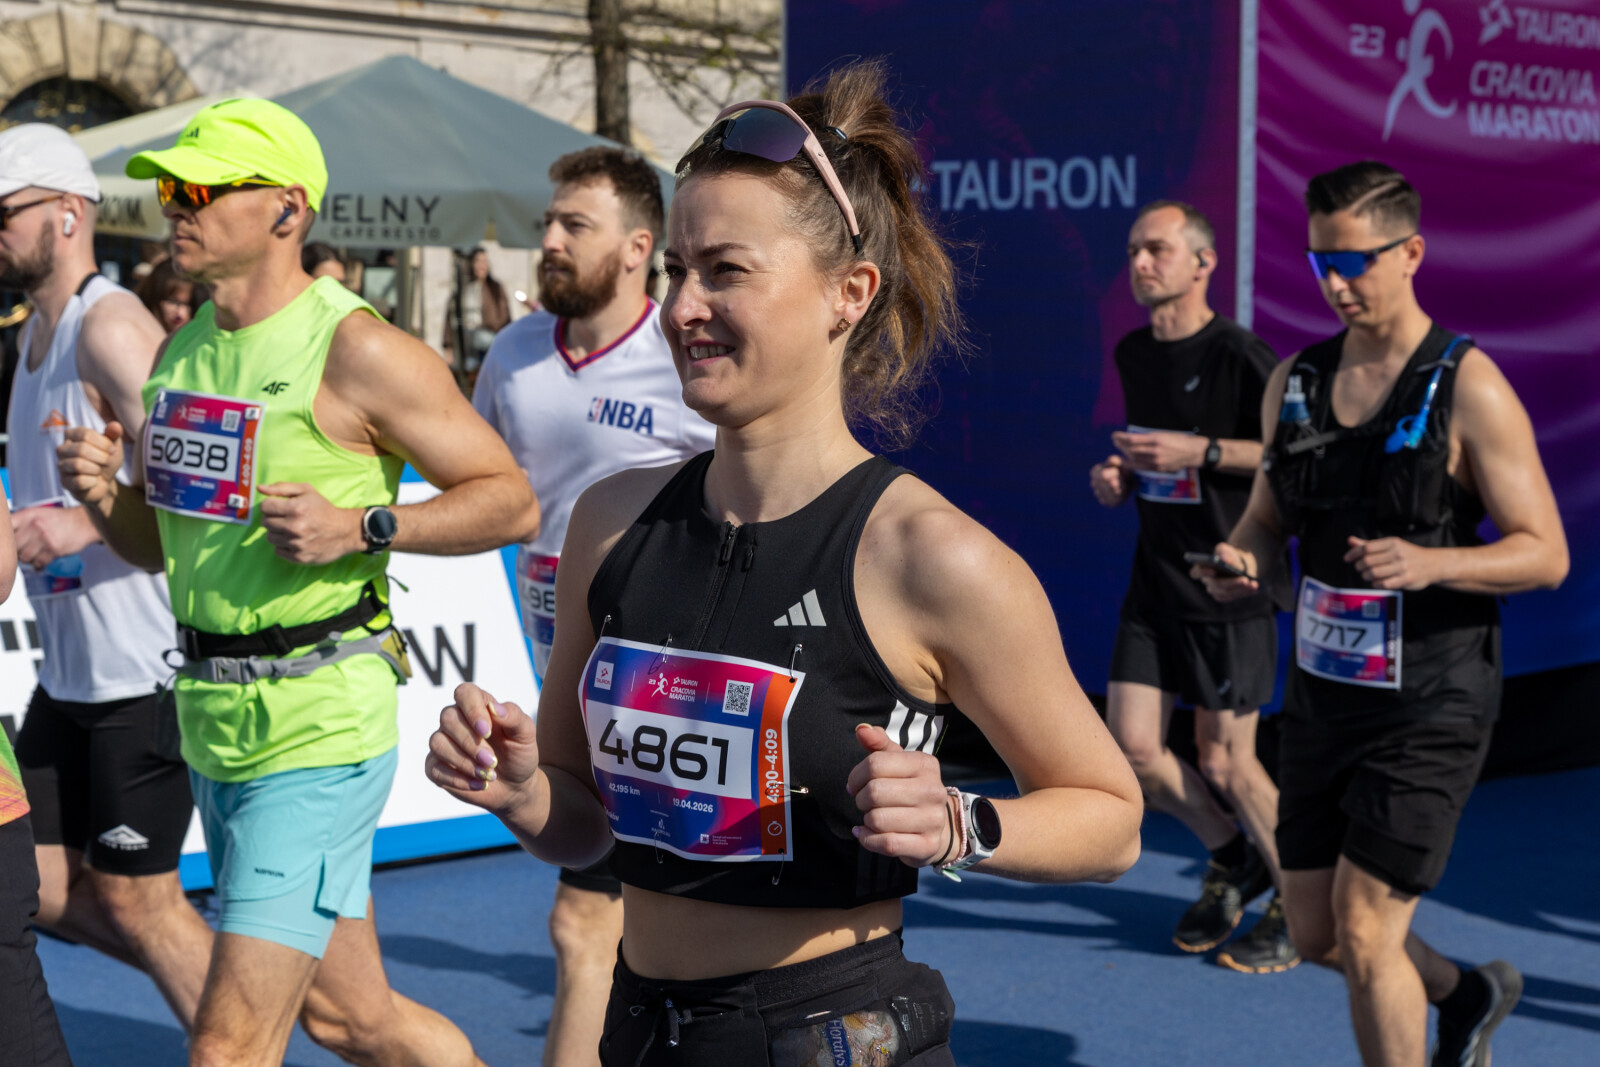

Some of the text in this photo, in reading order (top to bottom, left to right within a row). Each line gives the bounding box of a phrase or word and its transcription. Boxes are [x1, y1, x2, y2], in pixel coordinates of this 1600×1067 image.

[1350, 23, 1385, 58] 23
[1469, 60, 1598, 105] CRACOVIA
[1468, 102, 1600, 144] MARATON
[931, 156, 1137, 211] TAURON
[262, 381, 290, 396] 4F
[599, 398, 654, 437] NBA
[151, 433, 229, 472] 5038
[1307, 616, 1368, 649] 7717
[668, 693, 696, 703] MARATON
[670, 686, 696, 696] CRACOVIA
[680, 678, 698, 687] TAURON
[598, 718, 729, 786] 4861
[765, 728, 779, 804] 4:00-4:09
[608, 782, 641, 796] 42,195 km
[672, 797, 714, 814] 19.04.2026
